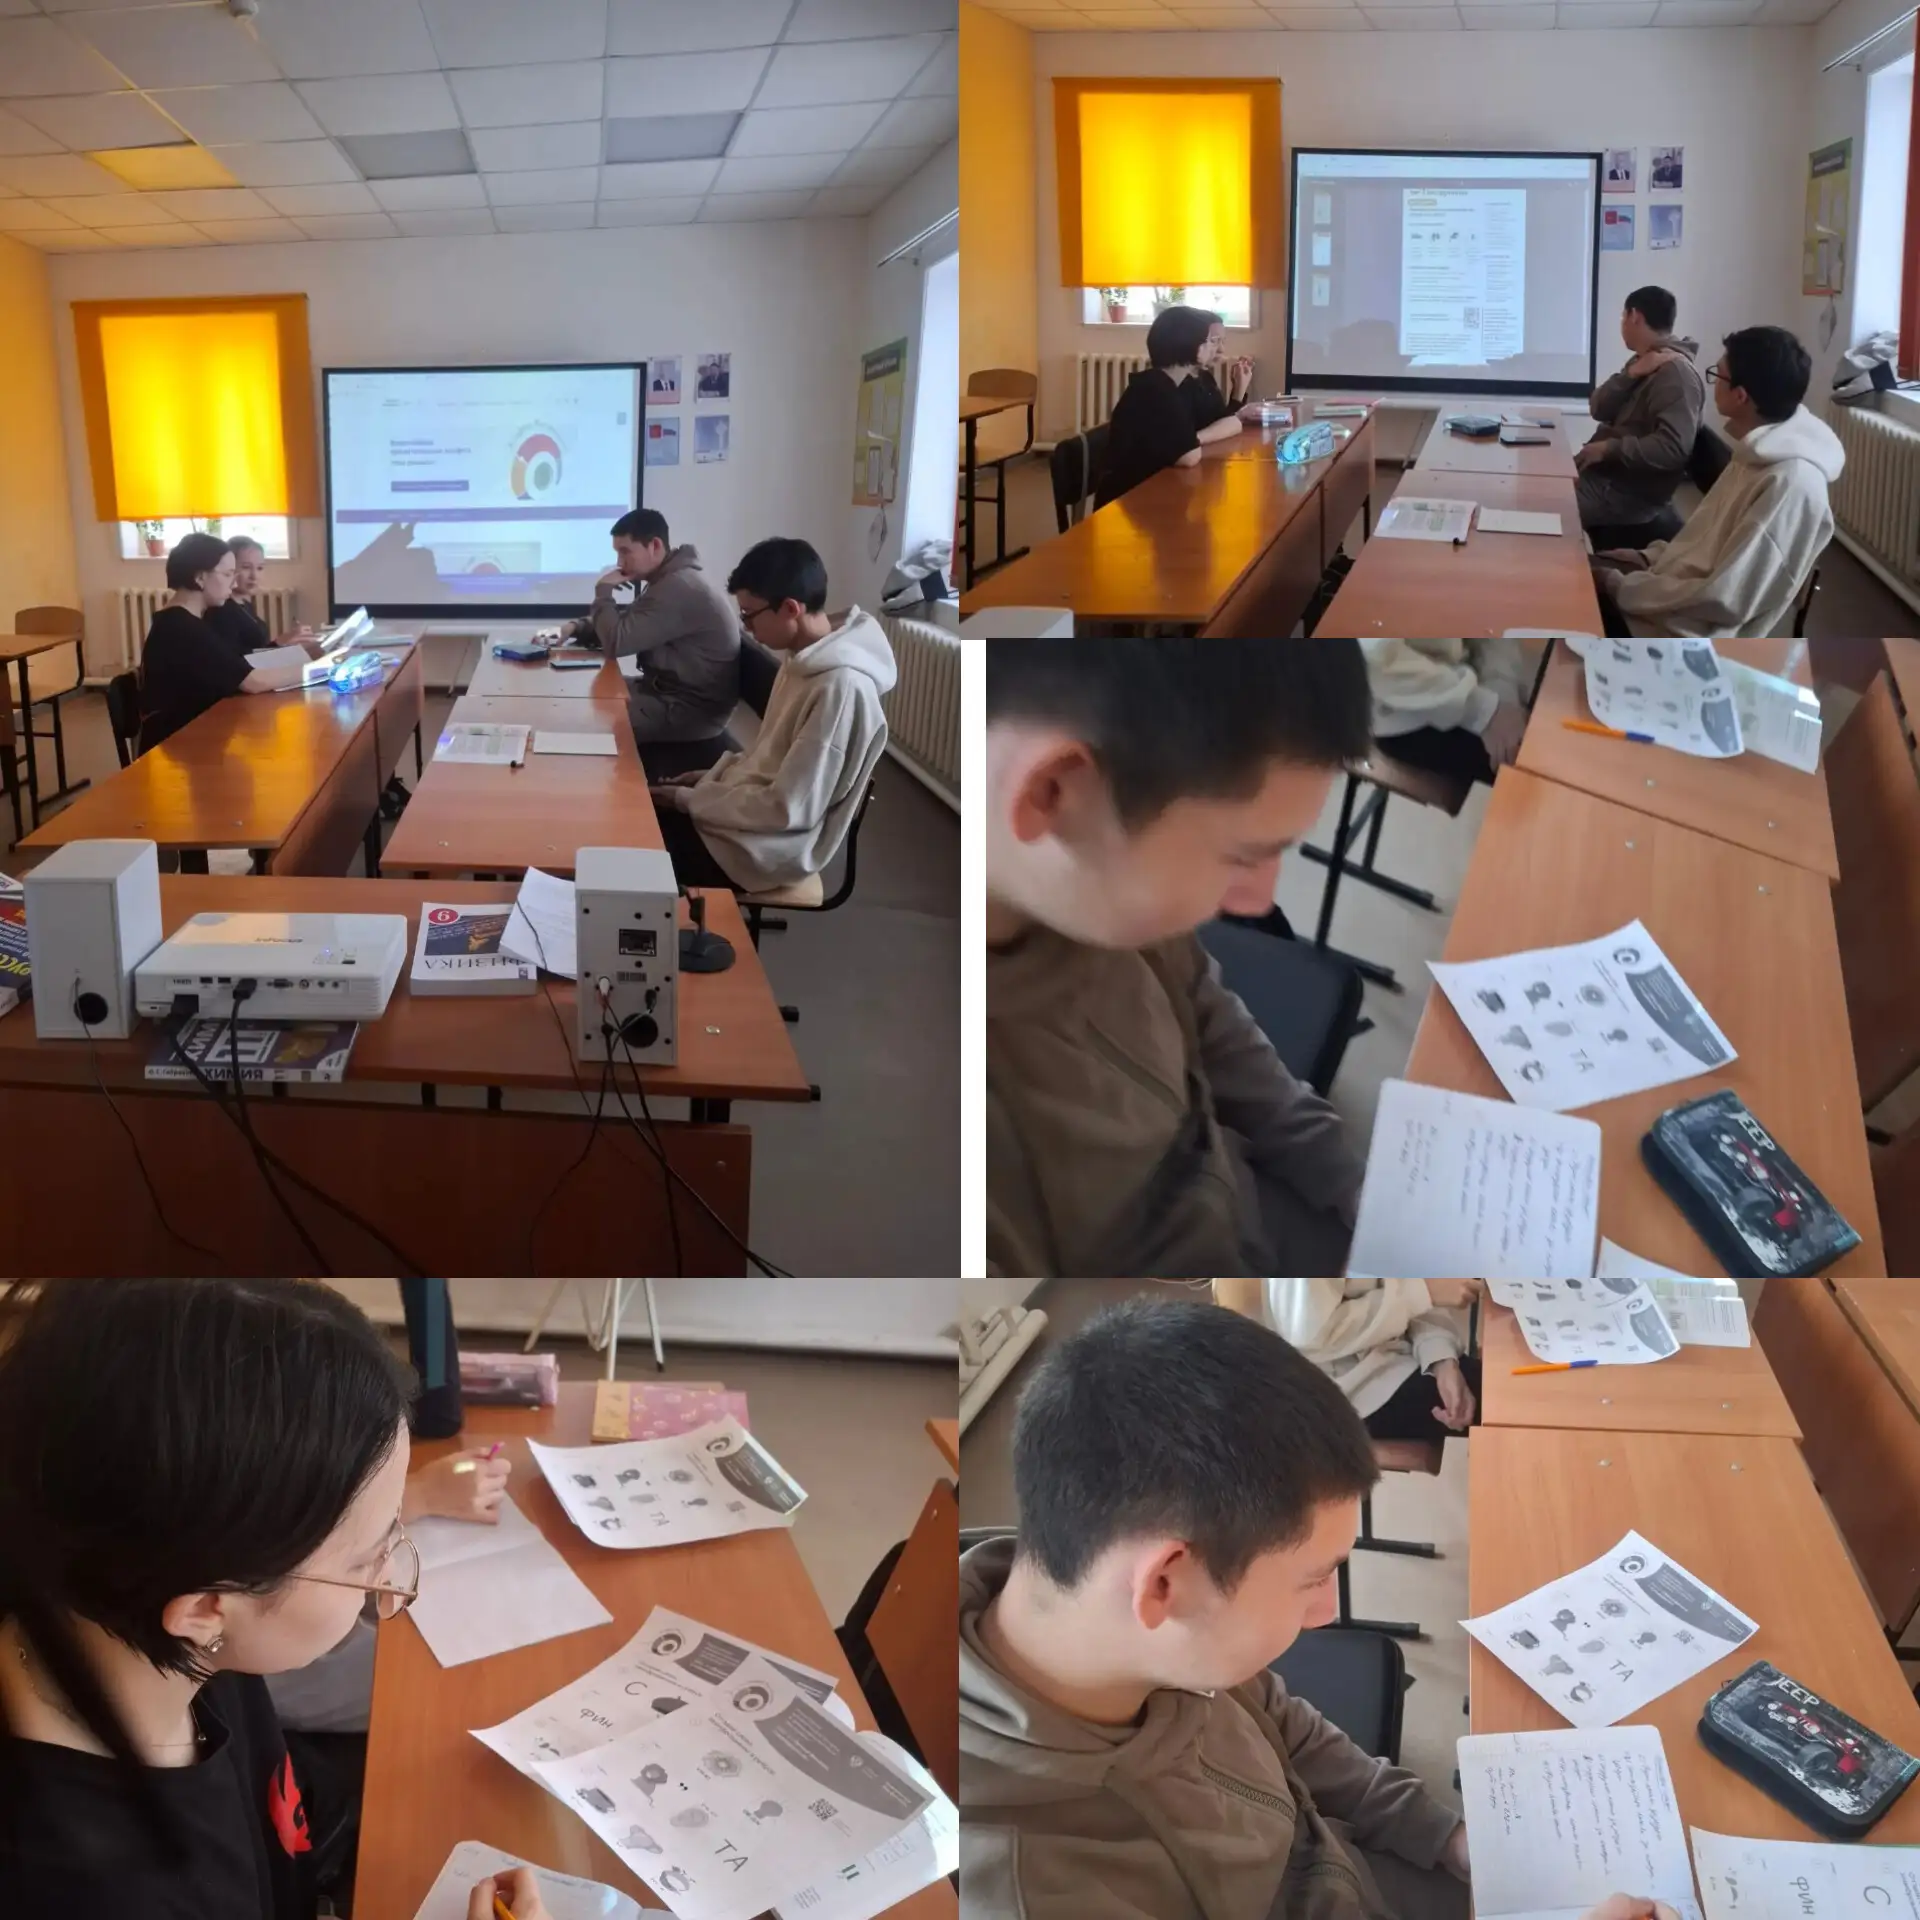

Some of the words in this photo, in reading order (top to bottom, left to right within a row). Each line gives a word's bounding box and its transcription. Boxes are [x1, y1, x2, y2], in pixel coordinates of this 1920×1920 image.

[1722, 1111, 1776, 1151] JEEP
[1608, 1658, 1635, 1683] ТА
[1763, 1676, 1820, 1706] JEEP
[580, 1708, 614, 1729] ФИН
[715, 1838, 749, 1873] ТА
[1789, 1876, 1815, 1915] ФИН
[1862, 1885, 1892, 1906] С
